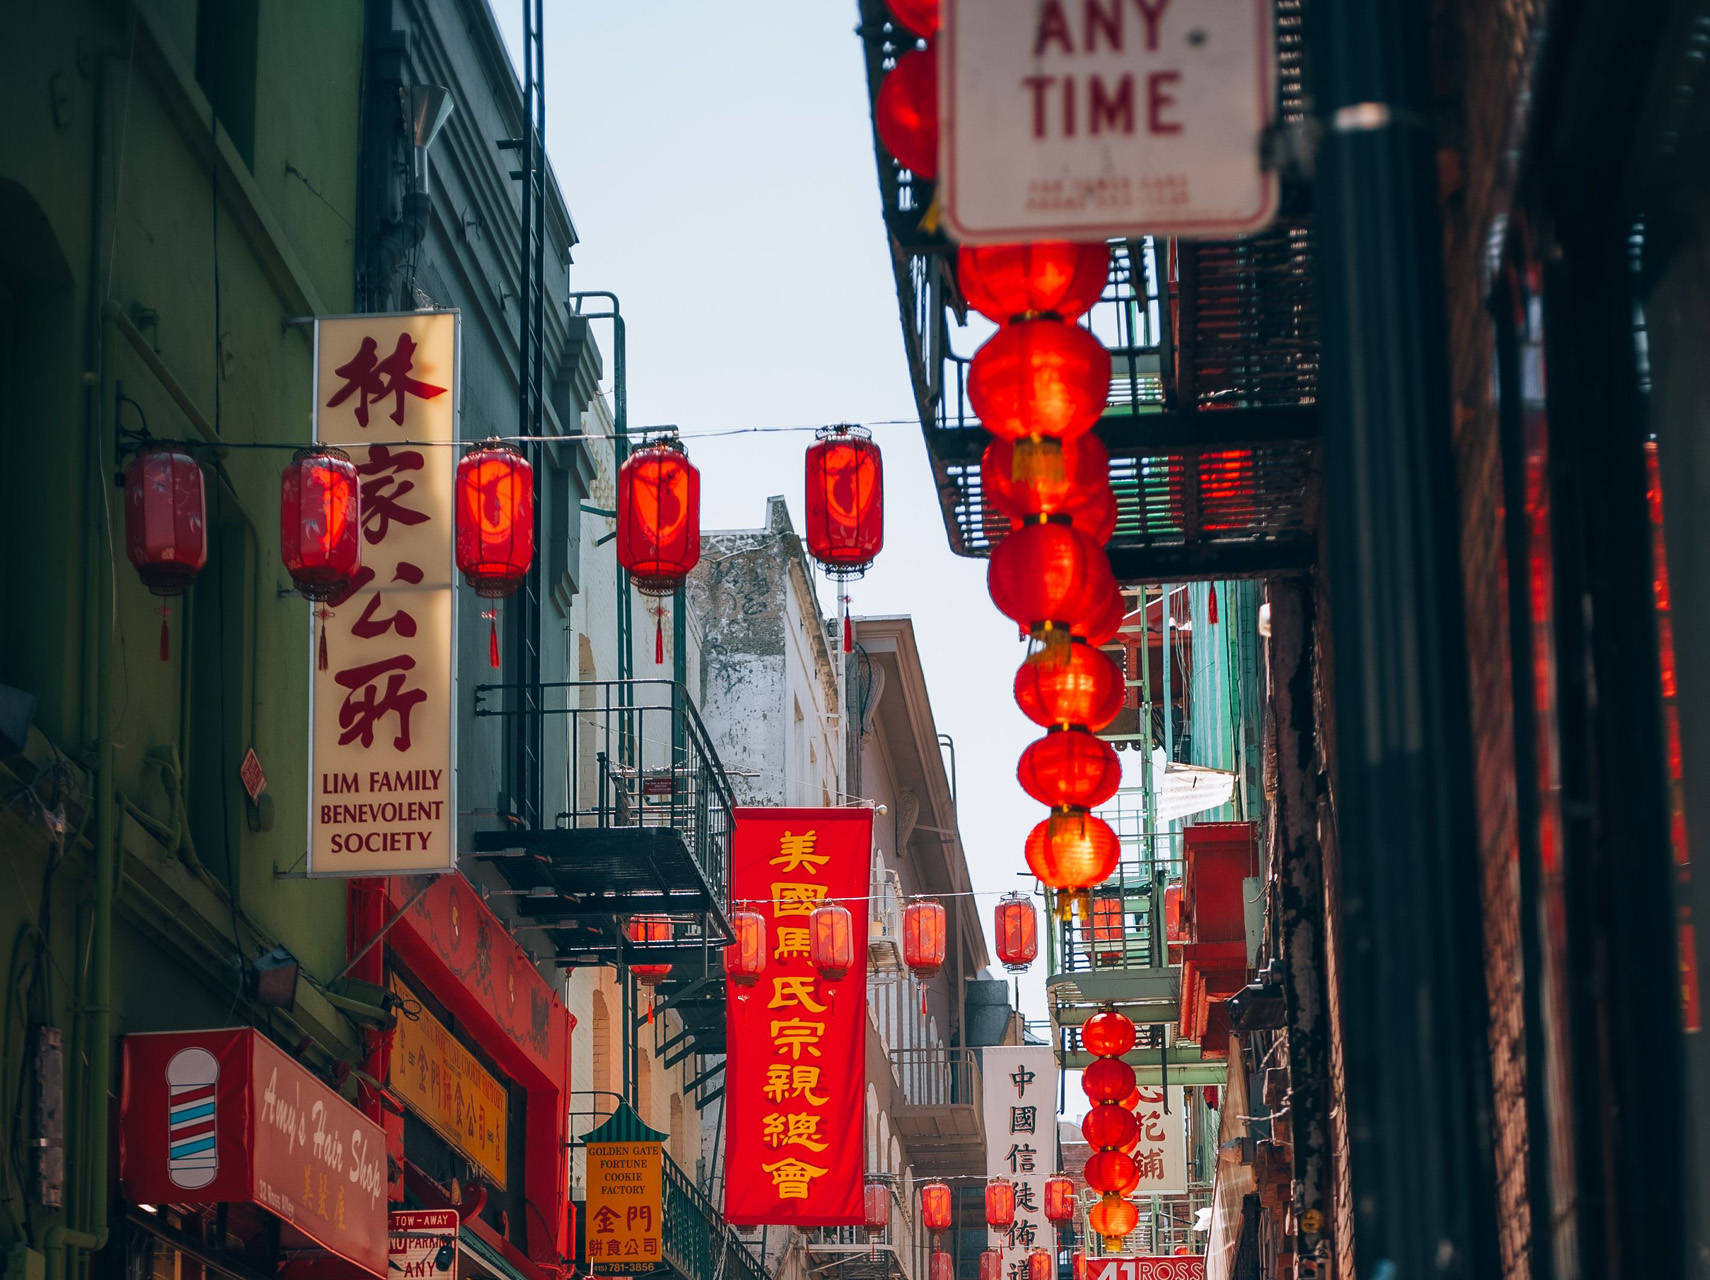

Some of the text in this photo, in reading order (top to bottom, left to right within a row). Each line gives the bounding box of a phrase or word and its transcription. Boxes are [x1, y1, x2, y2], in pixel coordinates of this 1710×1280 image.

[1033, 0, 1168, 57] ANY
[1023, 72, 1184, 140] TIME
[326, 331, 449, 752] 林家公所
[322, 769, 443, 795] LIM FAMILY
[320, 801, 444, 824] BENEVOLENT
[330, 831, 433, 854] SOCIETY
[761, 829, 832, 1200] 美國馬氏宗親總會
[261, 1067, 382, 1212] Amy's Hair Shop
[588, 1146, 659, 1157] GOLDEN GATE
[600, 1159, 648, 1169] FORTUNE
[604, 1172, 643, 1182] COOKIE
[601, 1185, 646, 1195] FACTORY
[592, 1204, 652, 1234] 金門
[588, 1238, 658, 1257] 餅食公司
[404, 1261, 437, 1278] ANY
[608, 1263, 655, 1272] 781-3856
